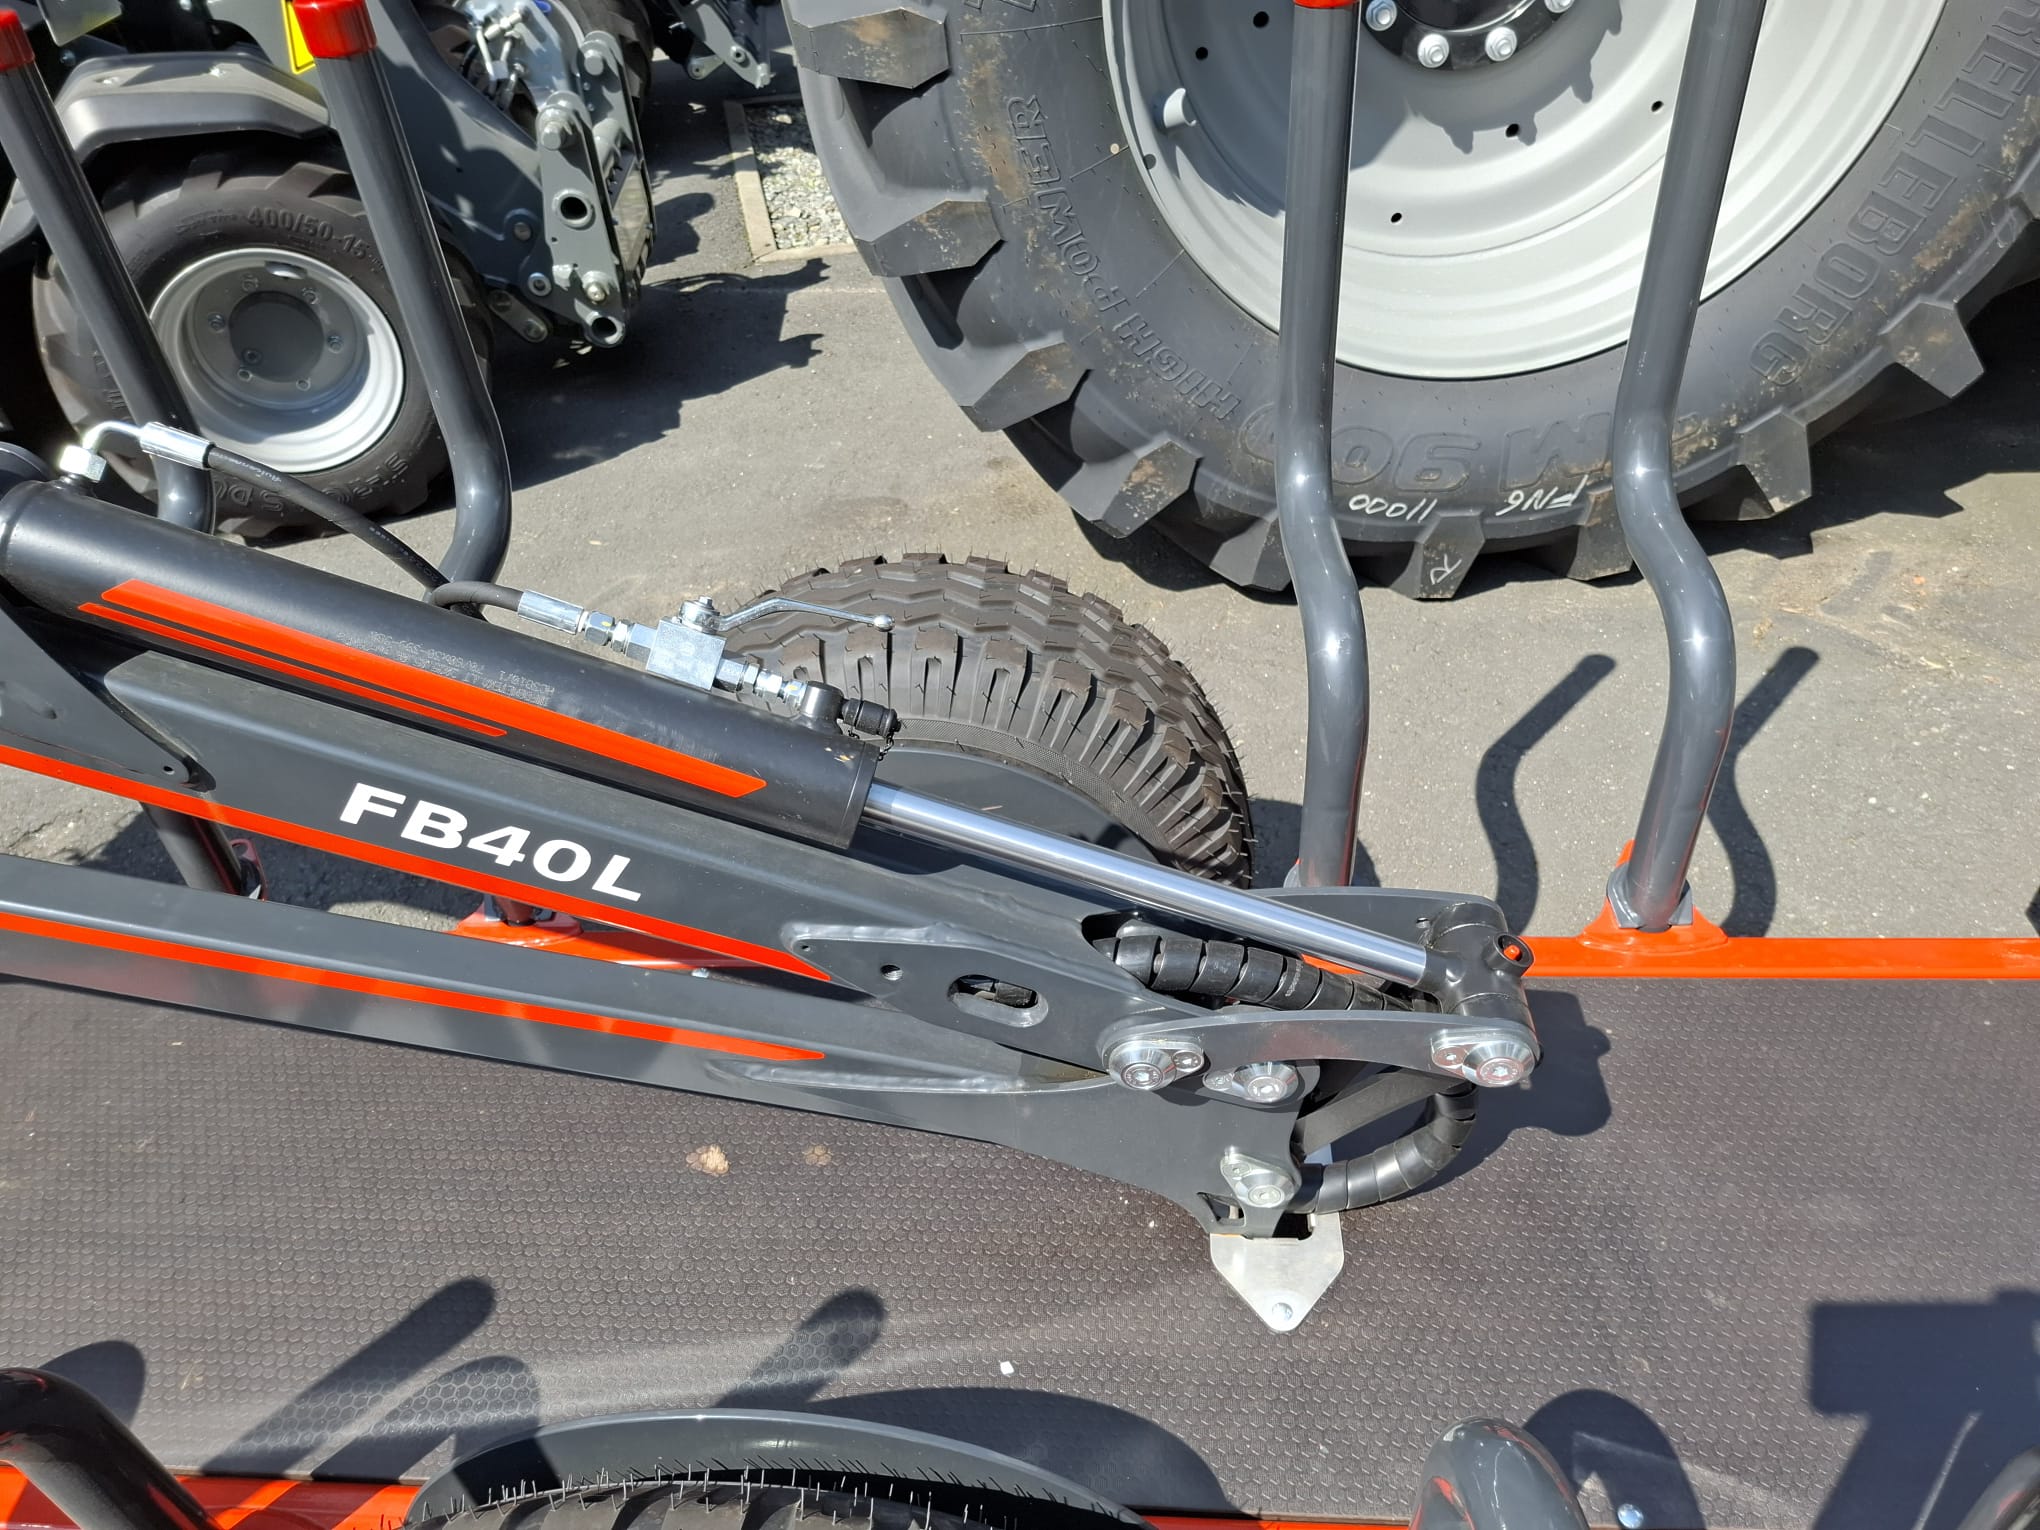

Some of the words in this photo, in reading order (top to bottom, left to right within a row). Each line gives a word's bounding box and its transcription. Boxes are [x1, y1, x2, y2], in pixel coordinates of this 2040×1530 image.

[1004, 94, 1131, 313] POWER
[1112, 311, 1241, 420] HIGH
[339, 782, 642, 902] FB40L
